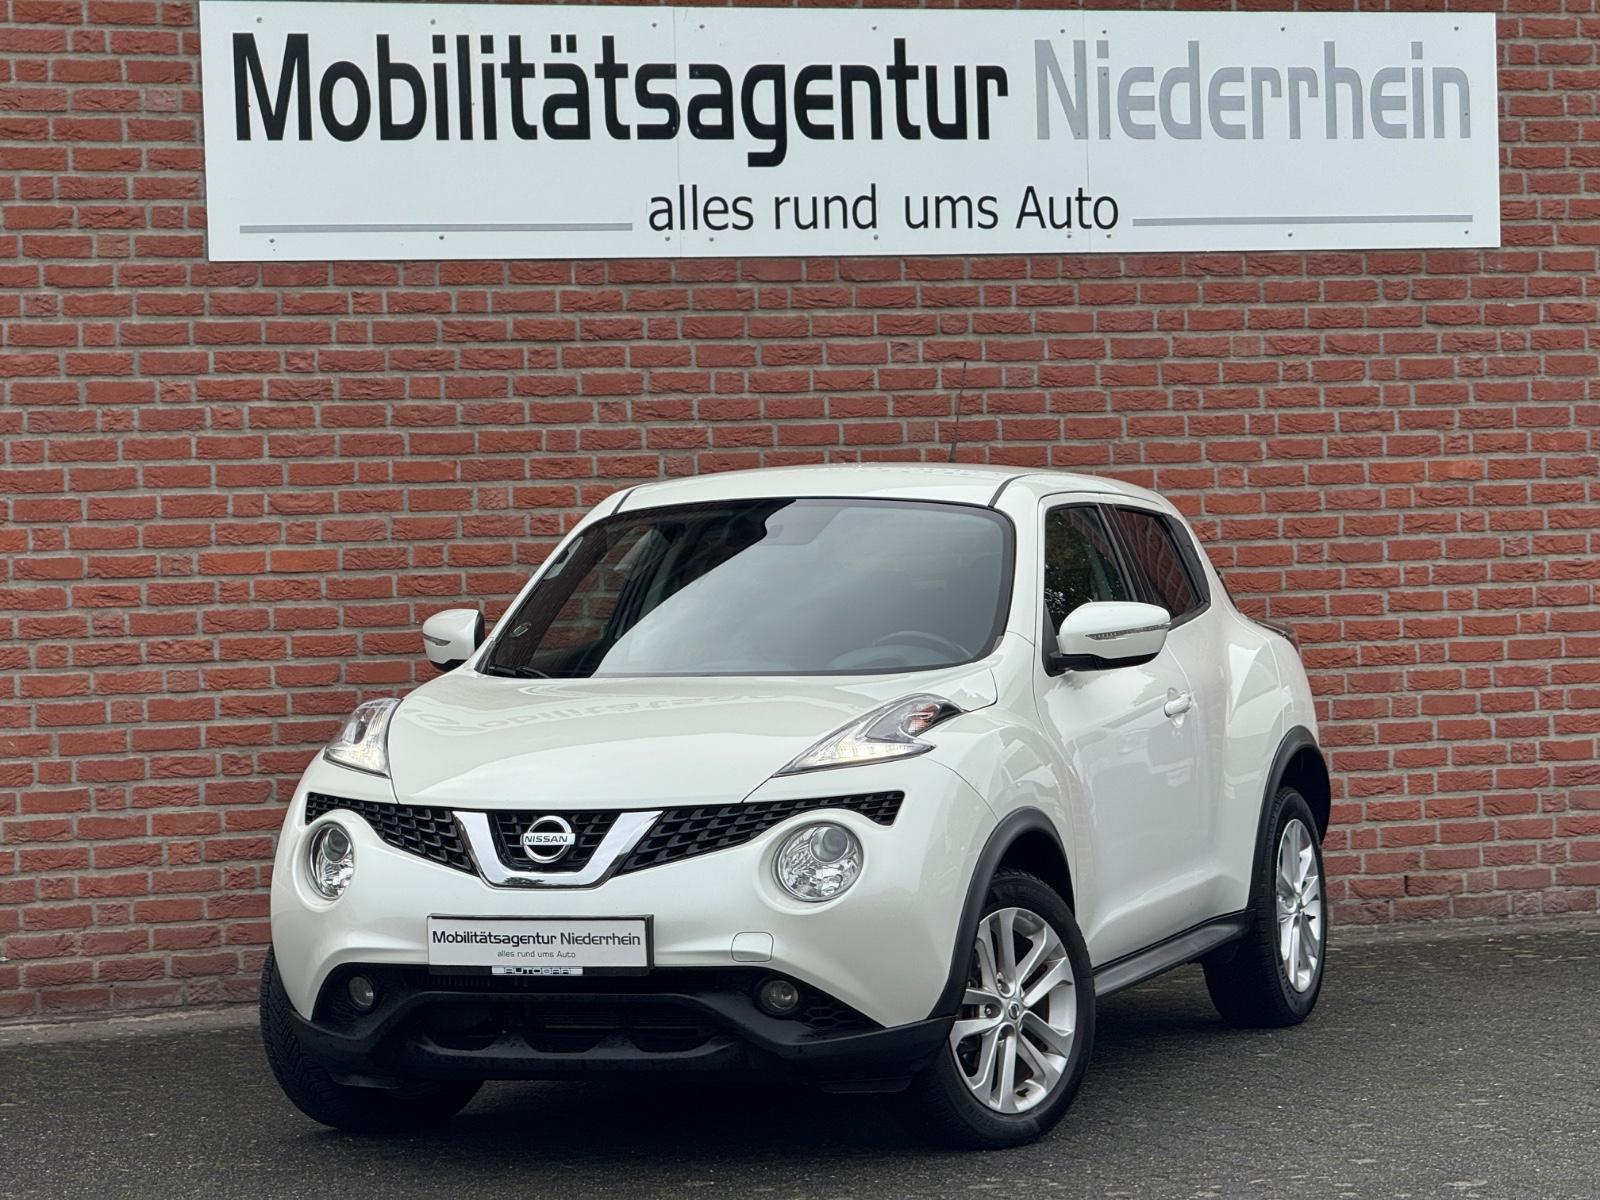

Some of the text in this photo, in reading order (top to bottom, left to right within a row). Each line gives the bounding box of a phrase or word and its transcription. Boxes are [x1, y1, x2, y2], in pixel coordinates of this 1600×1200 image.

[233, 32, 1472, 168] Mobilitätsagentur Niederrhein
[649, 183, 1119, 231] alles rund ums Auto
[524, 835, 568, 843] NISSAN
[432, 930, 641, 948] Mobilitätsagentur Niederrhein
[497, 950, 515, 958] alles
[517, 950, 535, 958] rund
[556, 951, 576, 959] Auto
